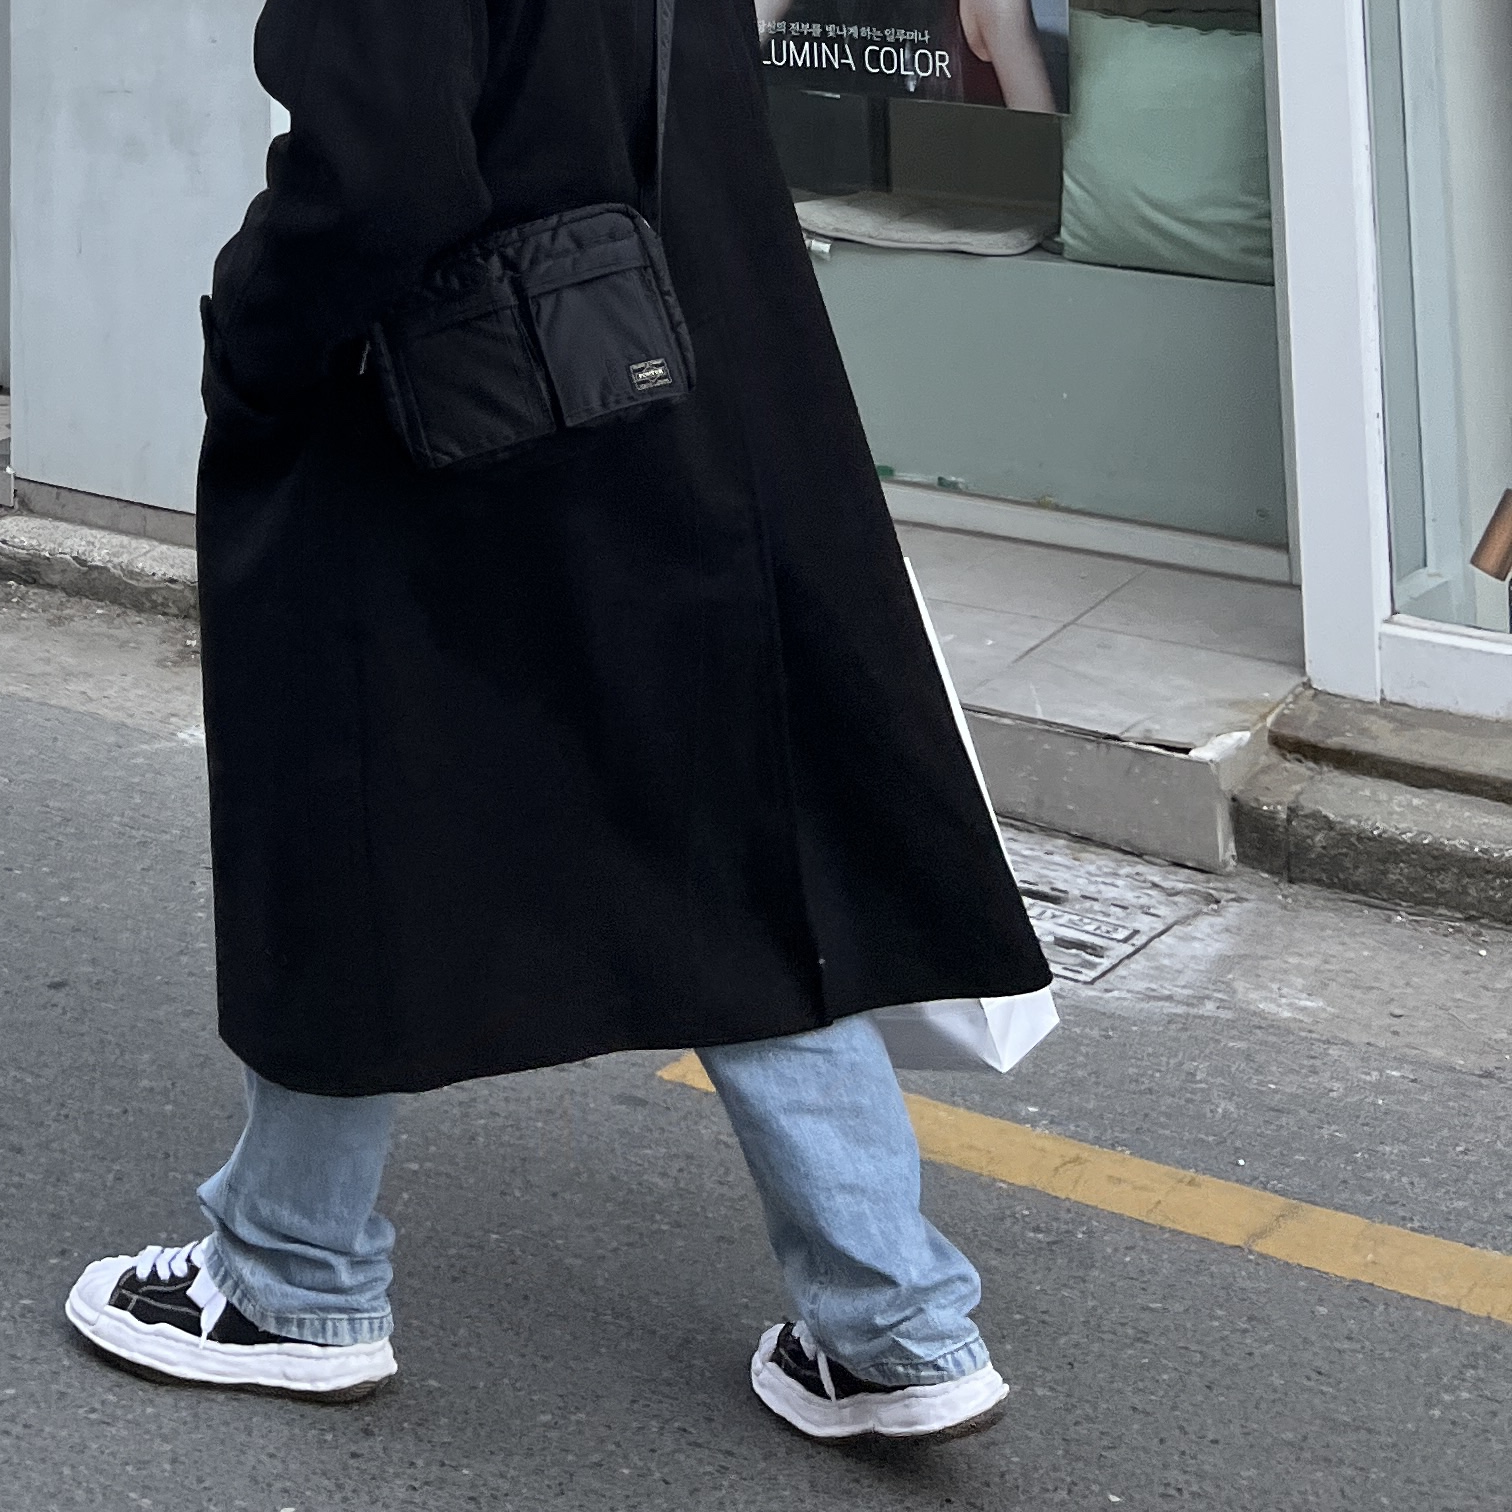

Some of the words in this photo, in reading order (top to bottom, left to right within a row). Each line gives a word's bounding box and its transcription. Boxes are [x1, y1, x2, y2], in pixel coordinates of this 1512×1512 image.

[860, 25, 884, 41] 하는
[762, 39, 856, 71] UMINA
[864, 45, 952, 78] COLOR
